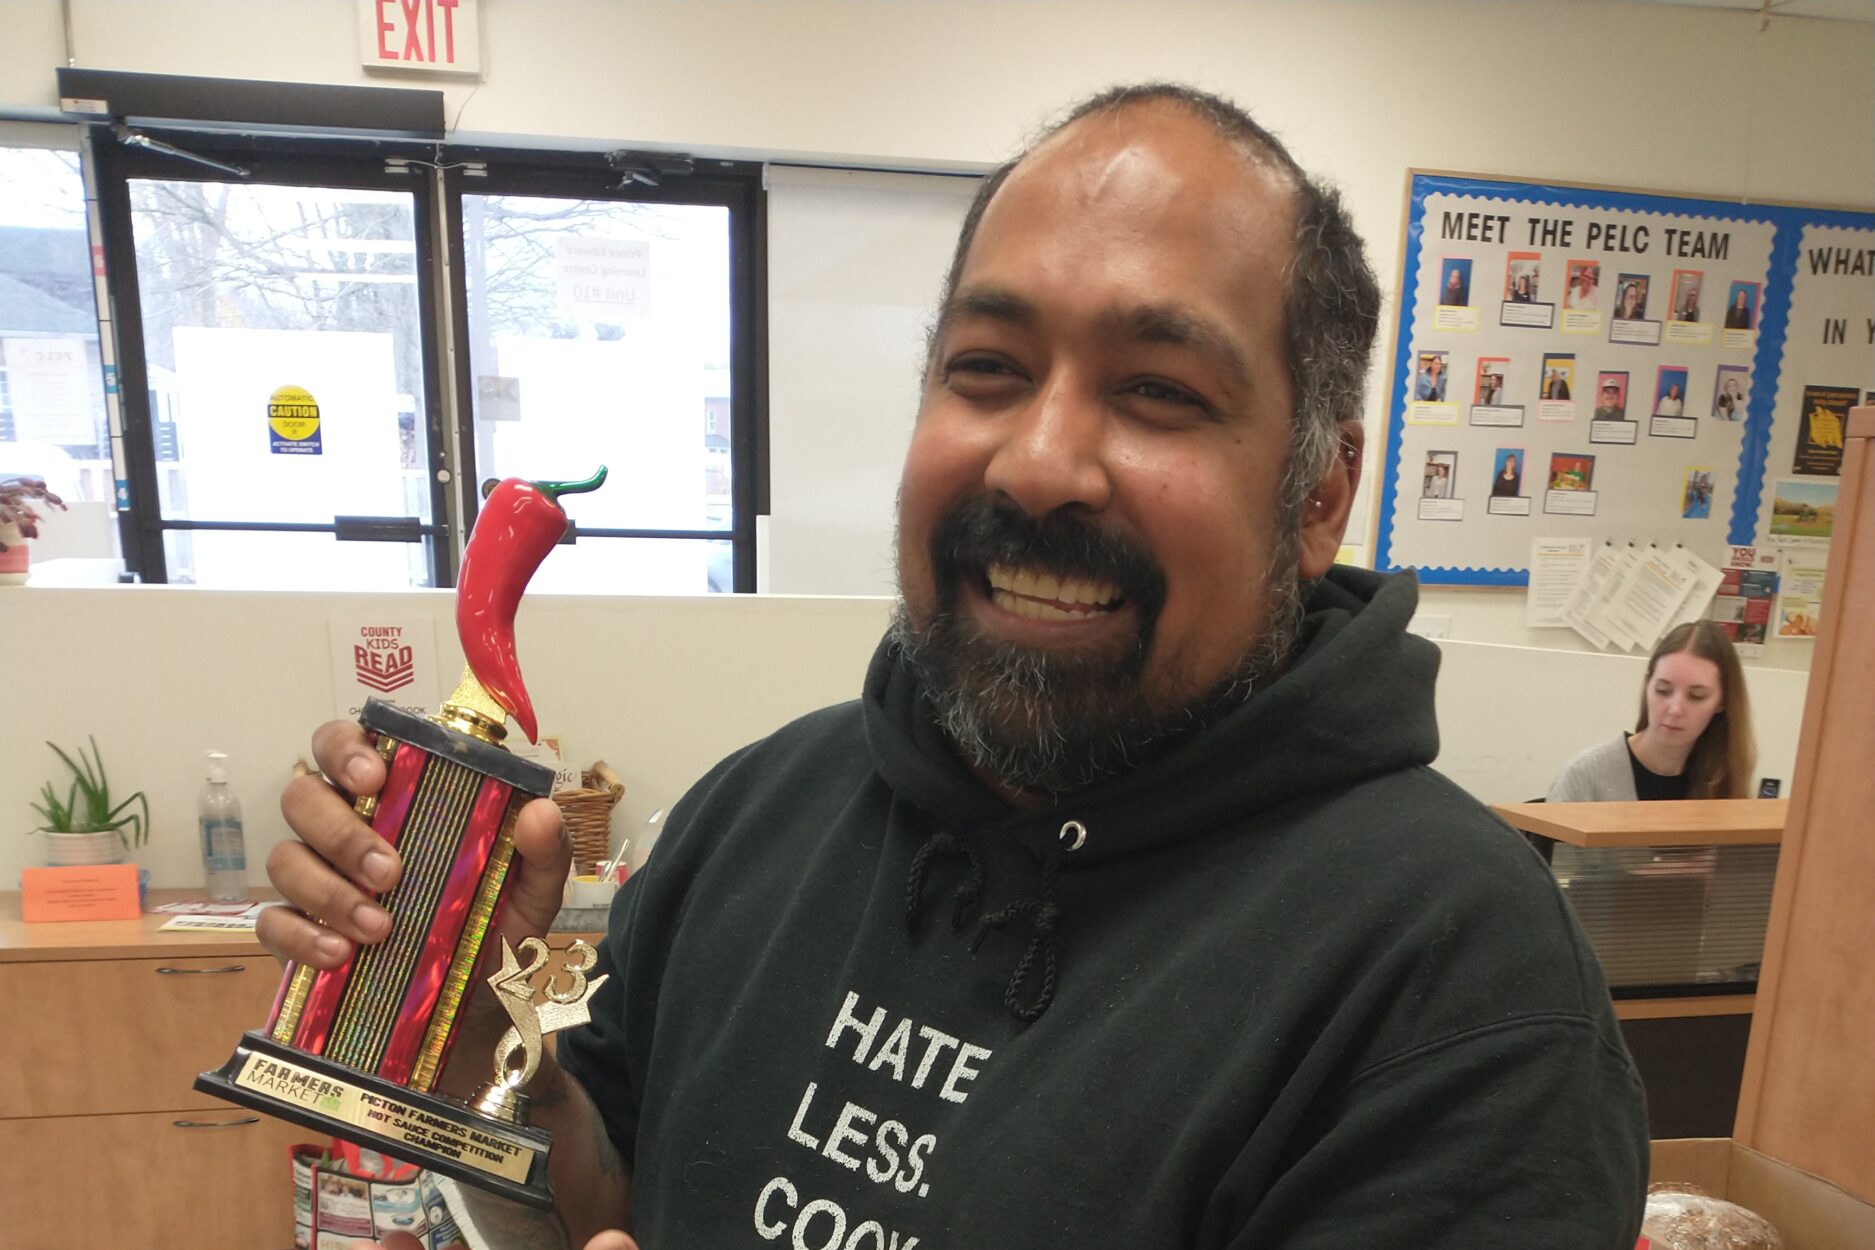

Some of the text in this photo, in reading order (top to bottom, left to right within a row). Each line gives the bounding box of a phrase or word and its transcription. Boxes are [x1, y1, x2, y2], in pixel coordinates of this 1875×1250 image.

[376, 0, 459, 64] EXIT
[1441, 211, 1730, 260] MEET THE PELC TEAM
[1808, 246, 1875, 276] WHAT
[1822, 318, 1847, 345] IN
[269, 405, 318, 417] CAUTION
[360, 626, 402, 637] COUNTY
[366, 638, 399, 650] KIDS
[353, 644, 413, 674] READ
[824, 990, 993, 1104] HATE
[247, 1070, 324, 1105] MARKET
[253, 1058, 344, 1098] FARMERS
[360, 1092, 522, 1157] PICTON FARMERS MARKET
[367, 1108, 504, 1164] HOT SAUCE COMPETITION
[787, 1081, 937, 1199] LESS.
[403, 1132, 462, 1160] CHAMPION
